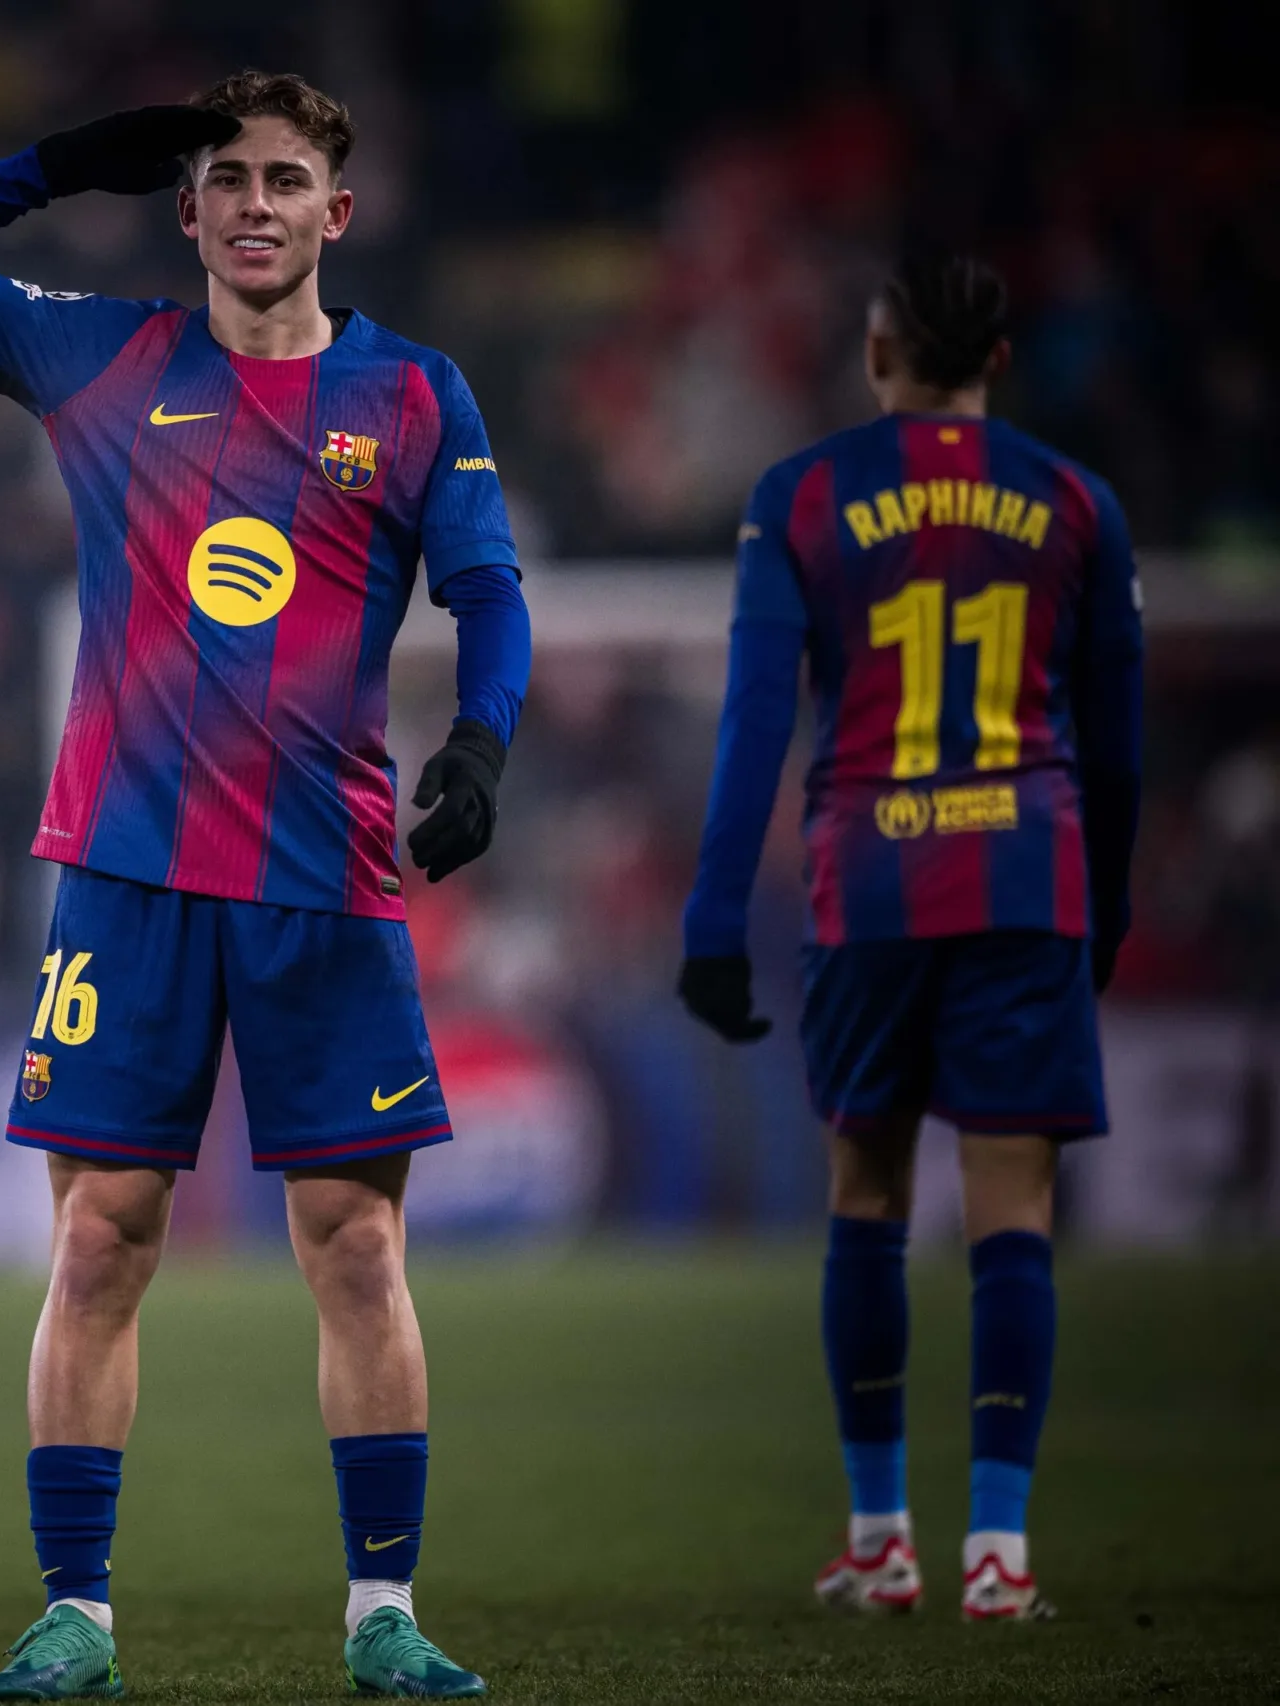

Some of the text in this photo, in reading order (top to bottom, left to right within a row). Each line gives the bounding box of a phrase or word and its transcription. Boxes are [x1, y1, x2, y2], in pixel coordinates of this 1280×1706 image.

[340, 455, 360, 465] FCB
[844, 478, 1052, 550] RAPHINHA
[870, 580, 1028, 780] 11
[31, 949, 98, 1045] 16
